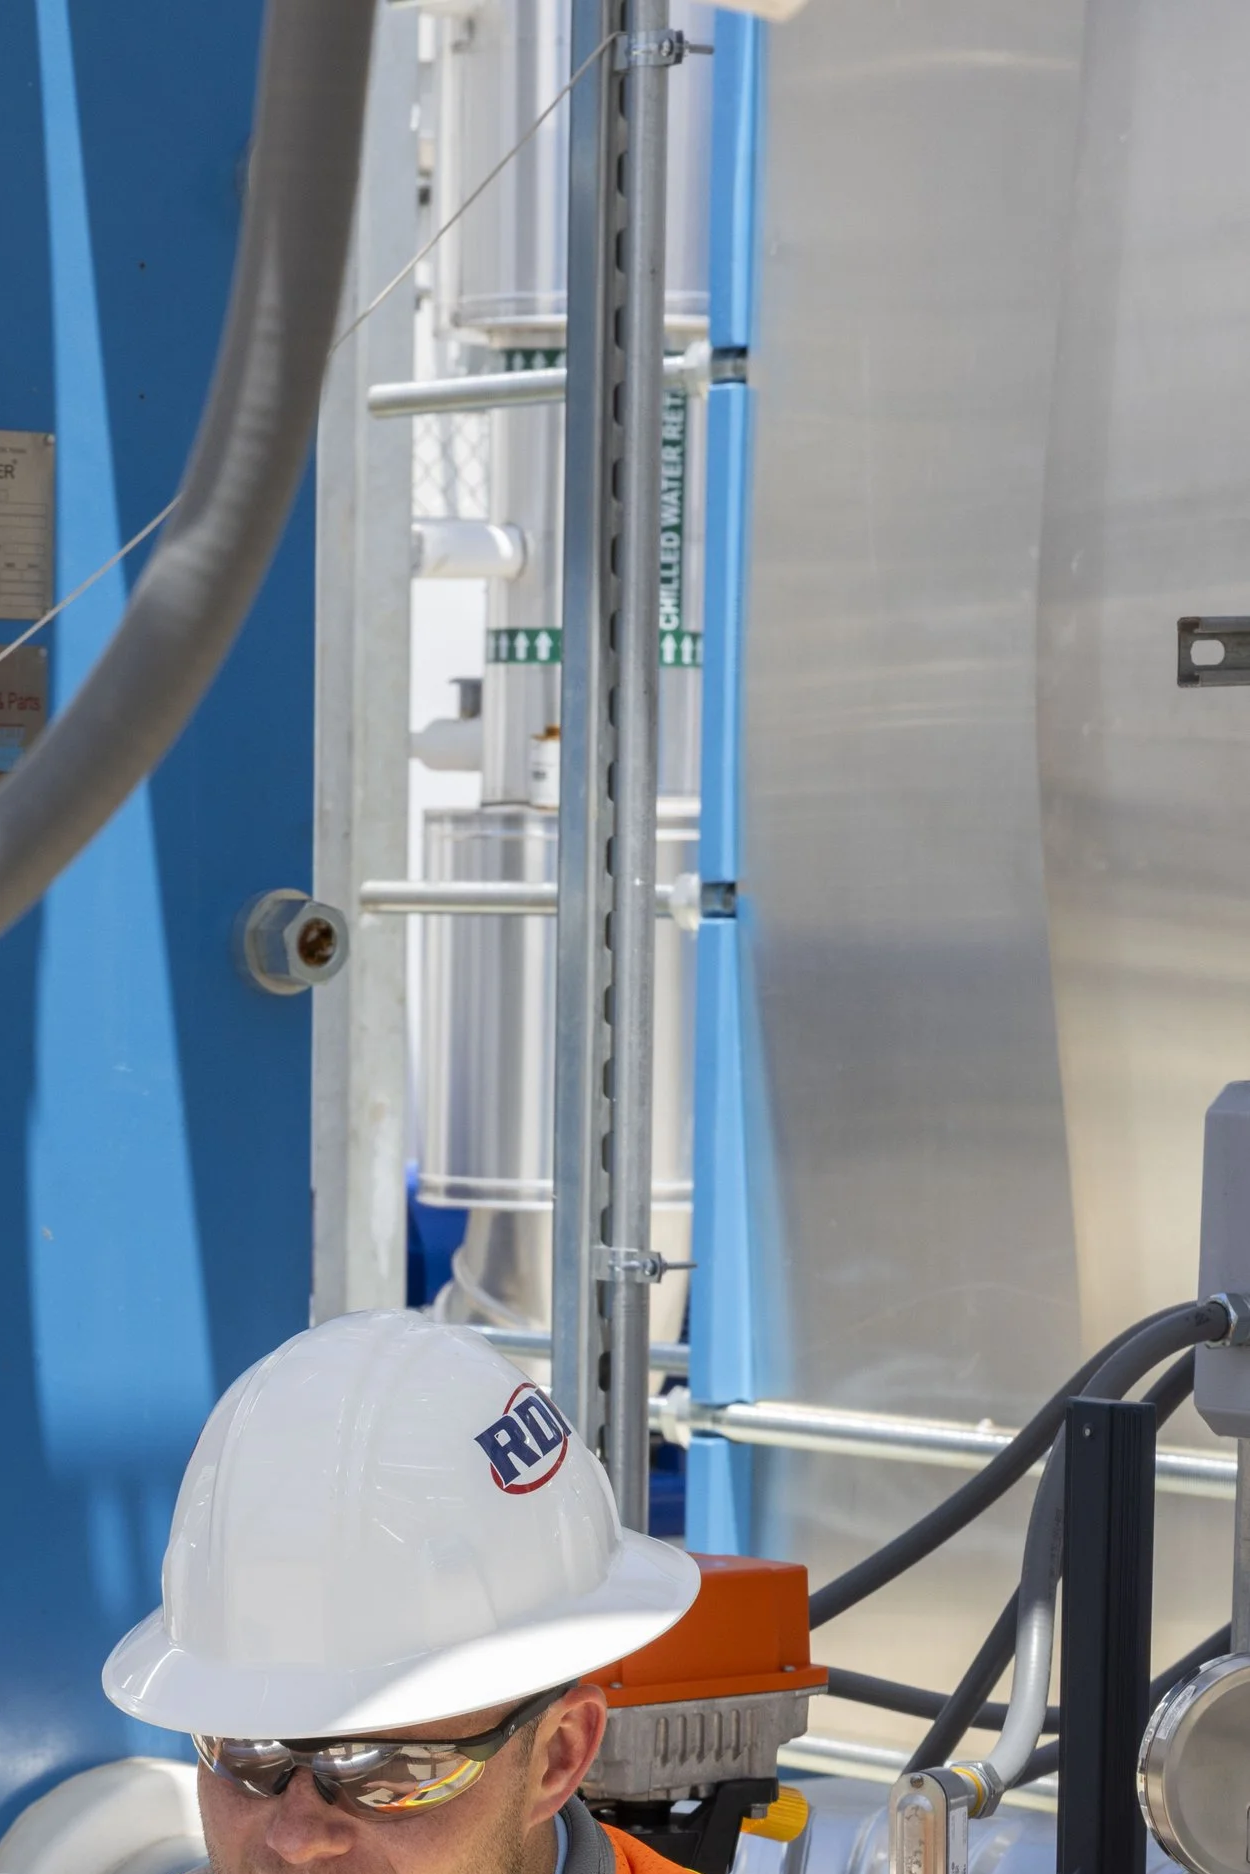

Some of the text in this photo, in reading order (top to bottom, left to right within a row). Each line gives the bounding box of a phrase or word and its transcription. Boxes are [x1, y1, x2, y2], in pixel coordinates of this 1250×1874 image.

[660, 446, 683, 527] WATER
[659, 531, 681, 631] CHILLED
[8, 692, 41, 711] Parts
